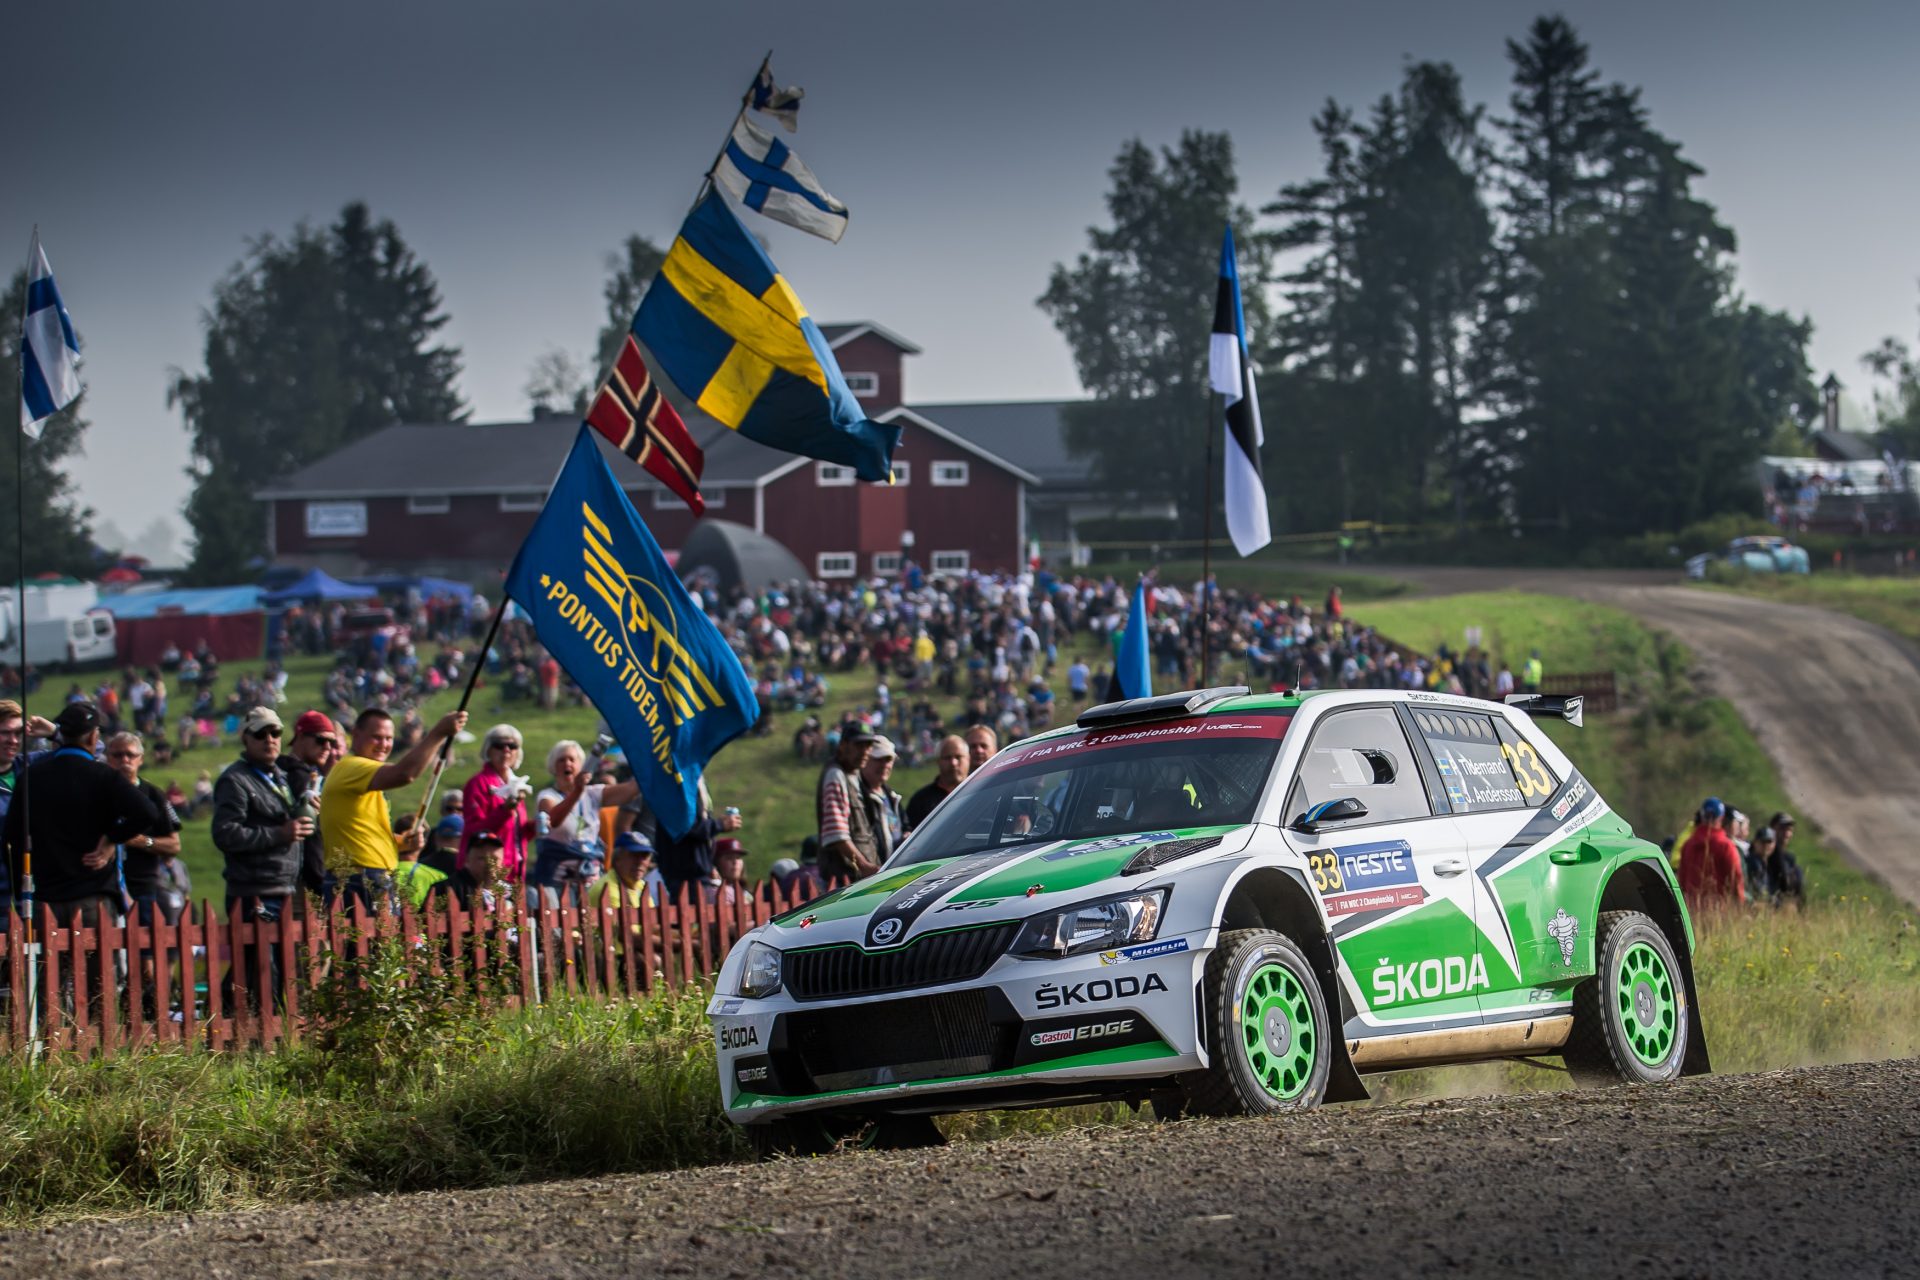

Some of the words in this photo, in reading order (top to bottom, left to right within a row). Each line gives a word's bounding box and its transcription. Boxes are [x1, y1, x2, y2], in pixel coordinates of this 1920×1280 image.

[547, 580, 623, 668] PONTUS
[1031, 746, 1052, 758] FIA
[1056, 740, 1084, 753] WRC
[1087, 736, 1099, 746] 2
[1101, 724, 1197, 743] Championship
[1458, 758, 1507, 776] Tidemand
[1500, 740, 1552, 798] 33
[1473, 785, 1524, 804] Andersson
[1310, 853, 1342, 892] 33
[1343, 850, 1407, 878] NESTE
[1363, 895, 1395, 908] Championship
[1131, 940, 1188, 957] MICHELIN
[1035, 972, 1169, 1010] ŠKODA
[1372, 952, 1490, 1006] ŠKODA
[721, 1025, 759, 1050] ŠKODA
[1041, 1030, 1073, 1044] Castrol
[1075, 1018, 1136, 1041] EDGE
